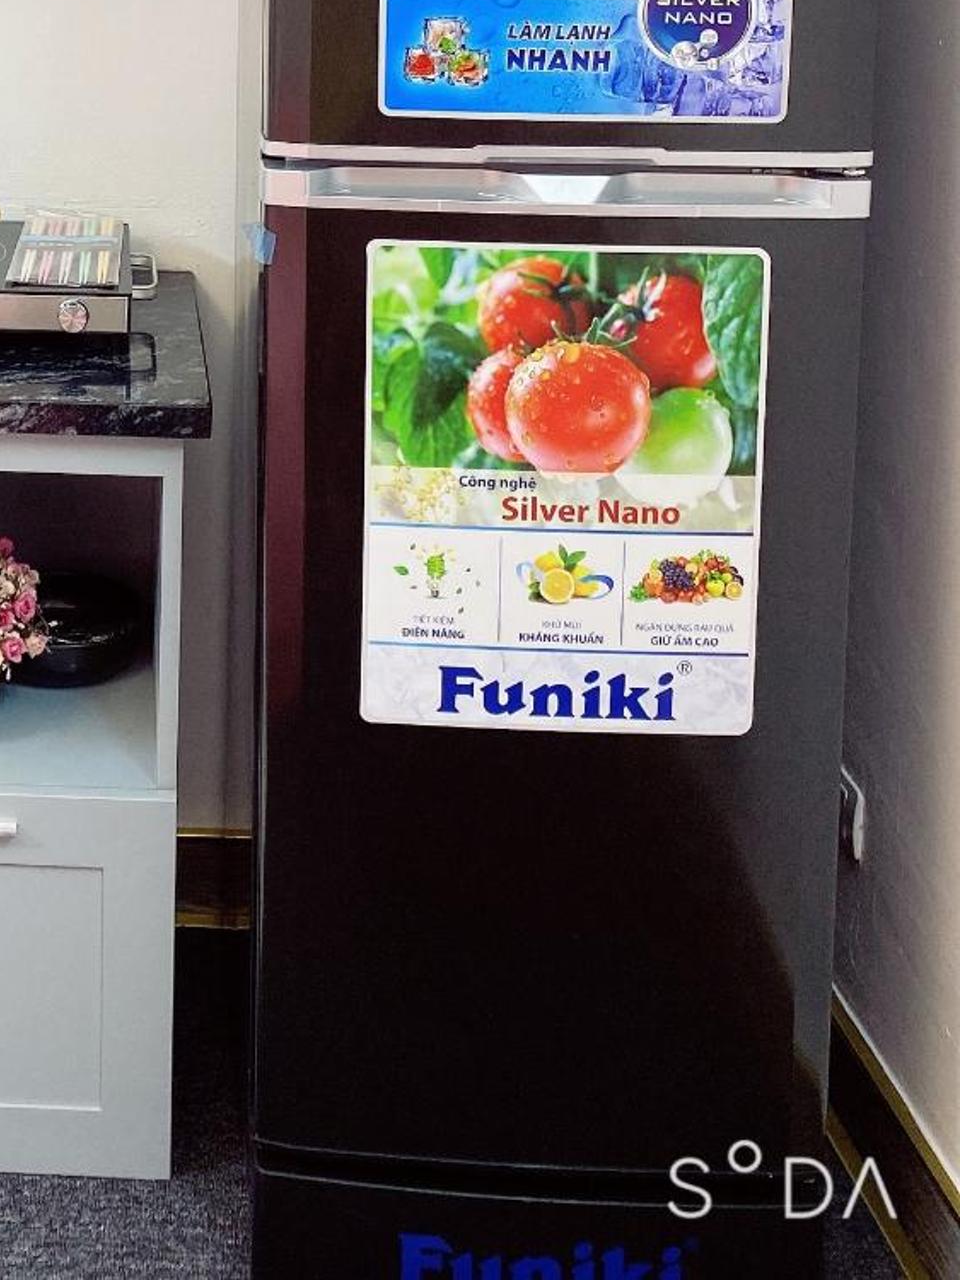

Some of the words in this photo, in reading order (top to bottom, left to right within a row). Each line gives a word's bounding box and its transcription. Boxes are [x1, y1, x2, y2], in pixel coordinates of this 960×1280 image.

[664, 11, 732, 25] NANO
[507, 21, 552, 40] LÀM
[555, 24, 611, 45] LẠNH
[506, 49, 611, 72] NHANH
[458, 475, 497, 491] Công
[500, 476, 537, 493] nghệ
[501, 496, 589, 522] Silver
[597, 499, 681, 525] Nano
